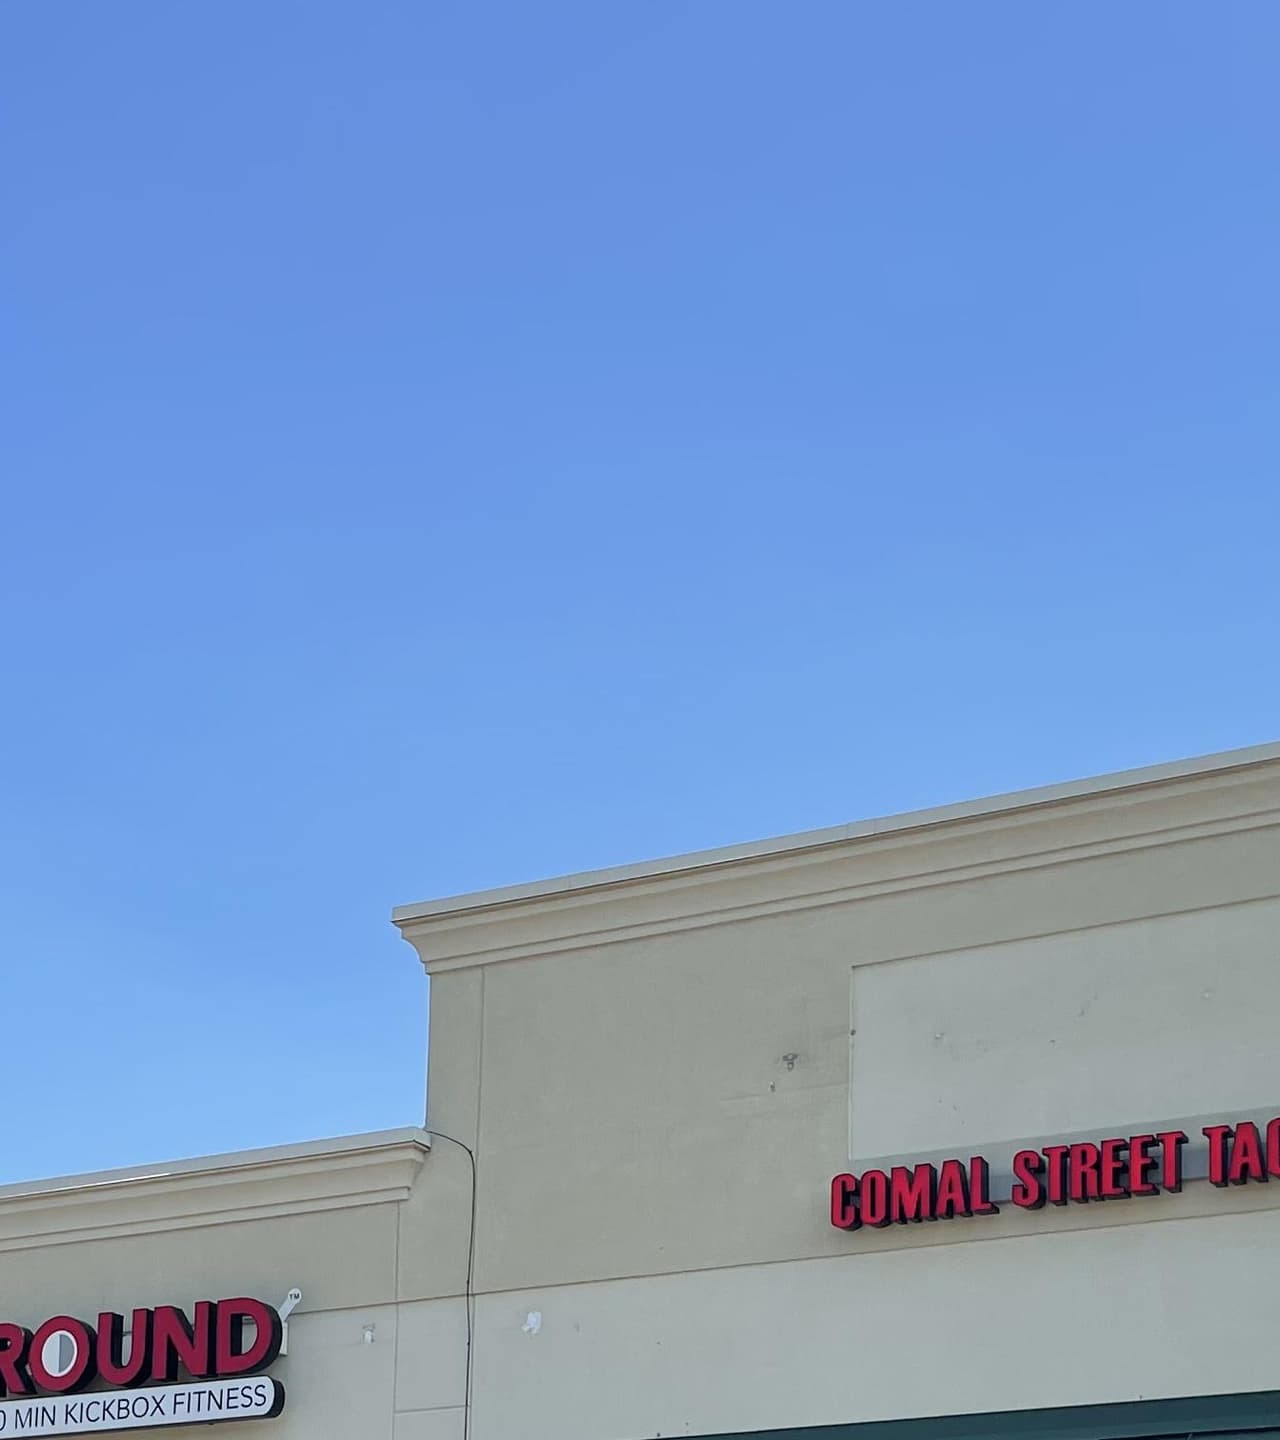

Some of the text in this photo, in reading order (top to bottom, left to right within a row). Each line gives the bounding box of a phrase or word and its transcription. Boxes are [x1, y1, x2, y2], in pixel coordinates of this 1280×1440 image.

[831, 1156, 997, 1231] COMAL
[1012, 1131, 1186, 1210] STREET
[14, 1406, 57, 1431] MIN
[64, 1395, 166, 1424] KICKBOX
[173, 1384, 267, 1415] FITNESS
